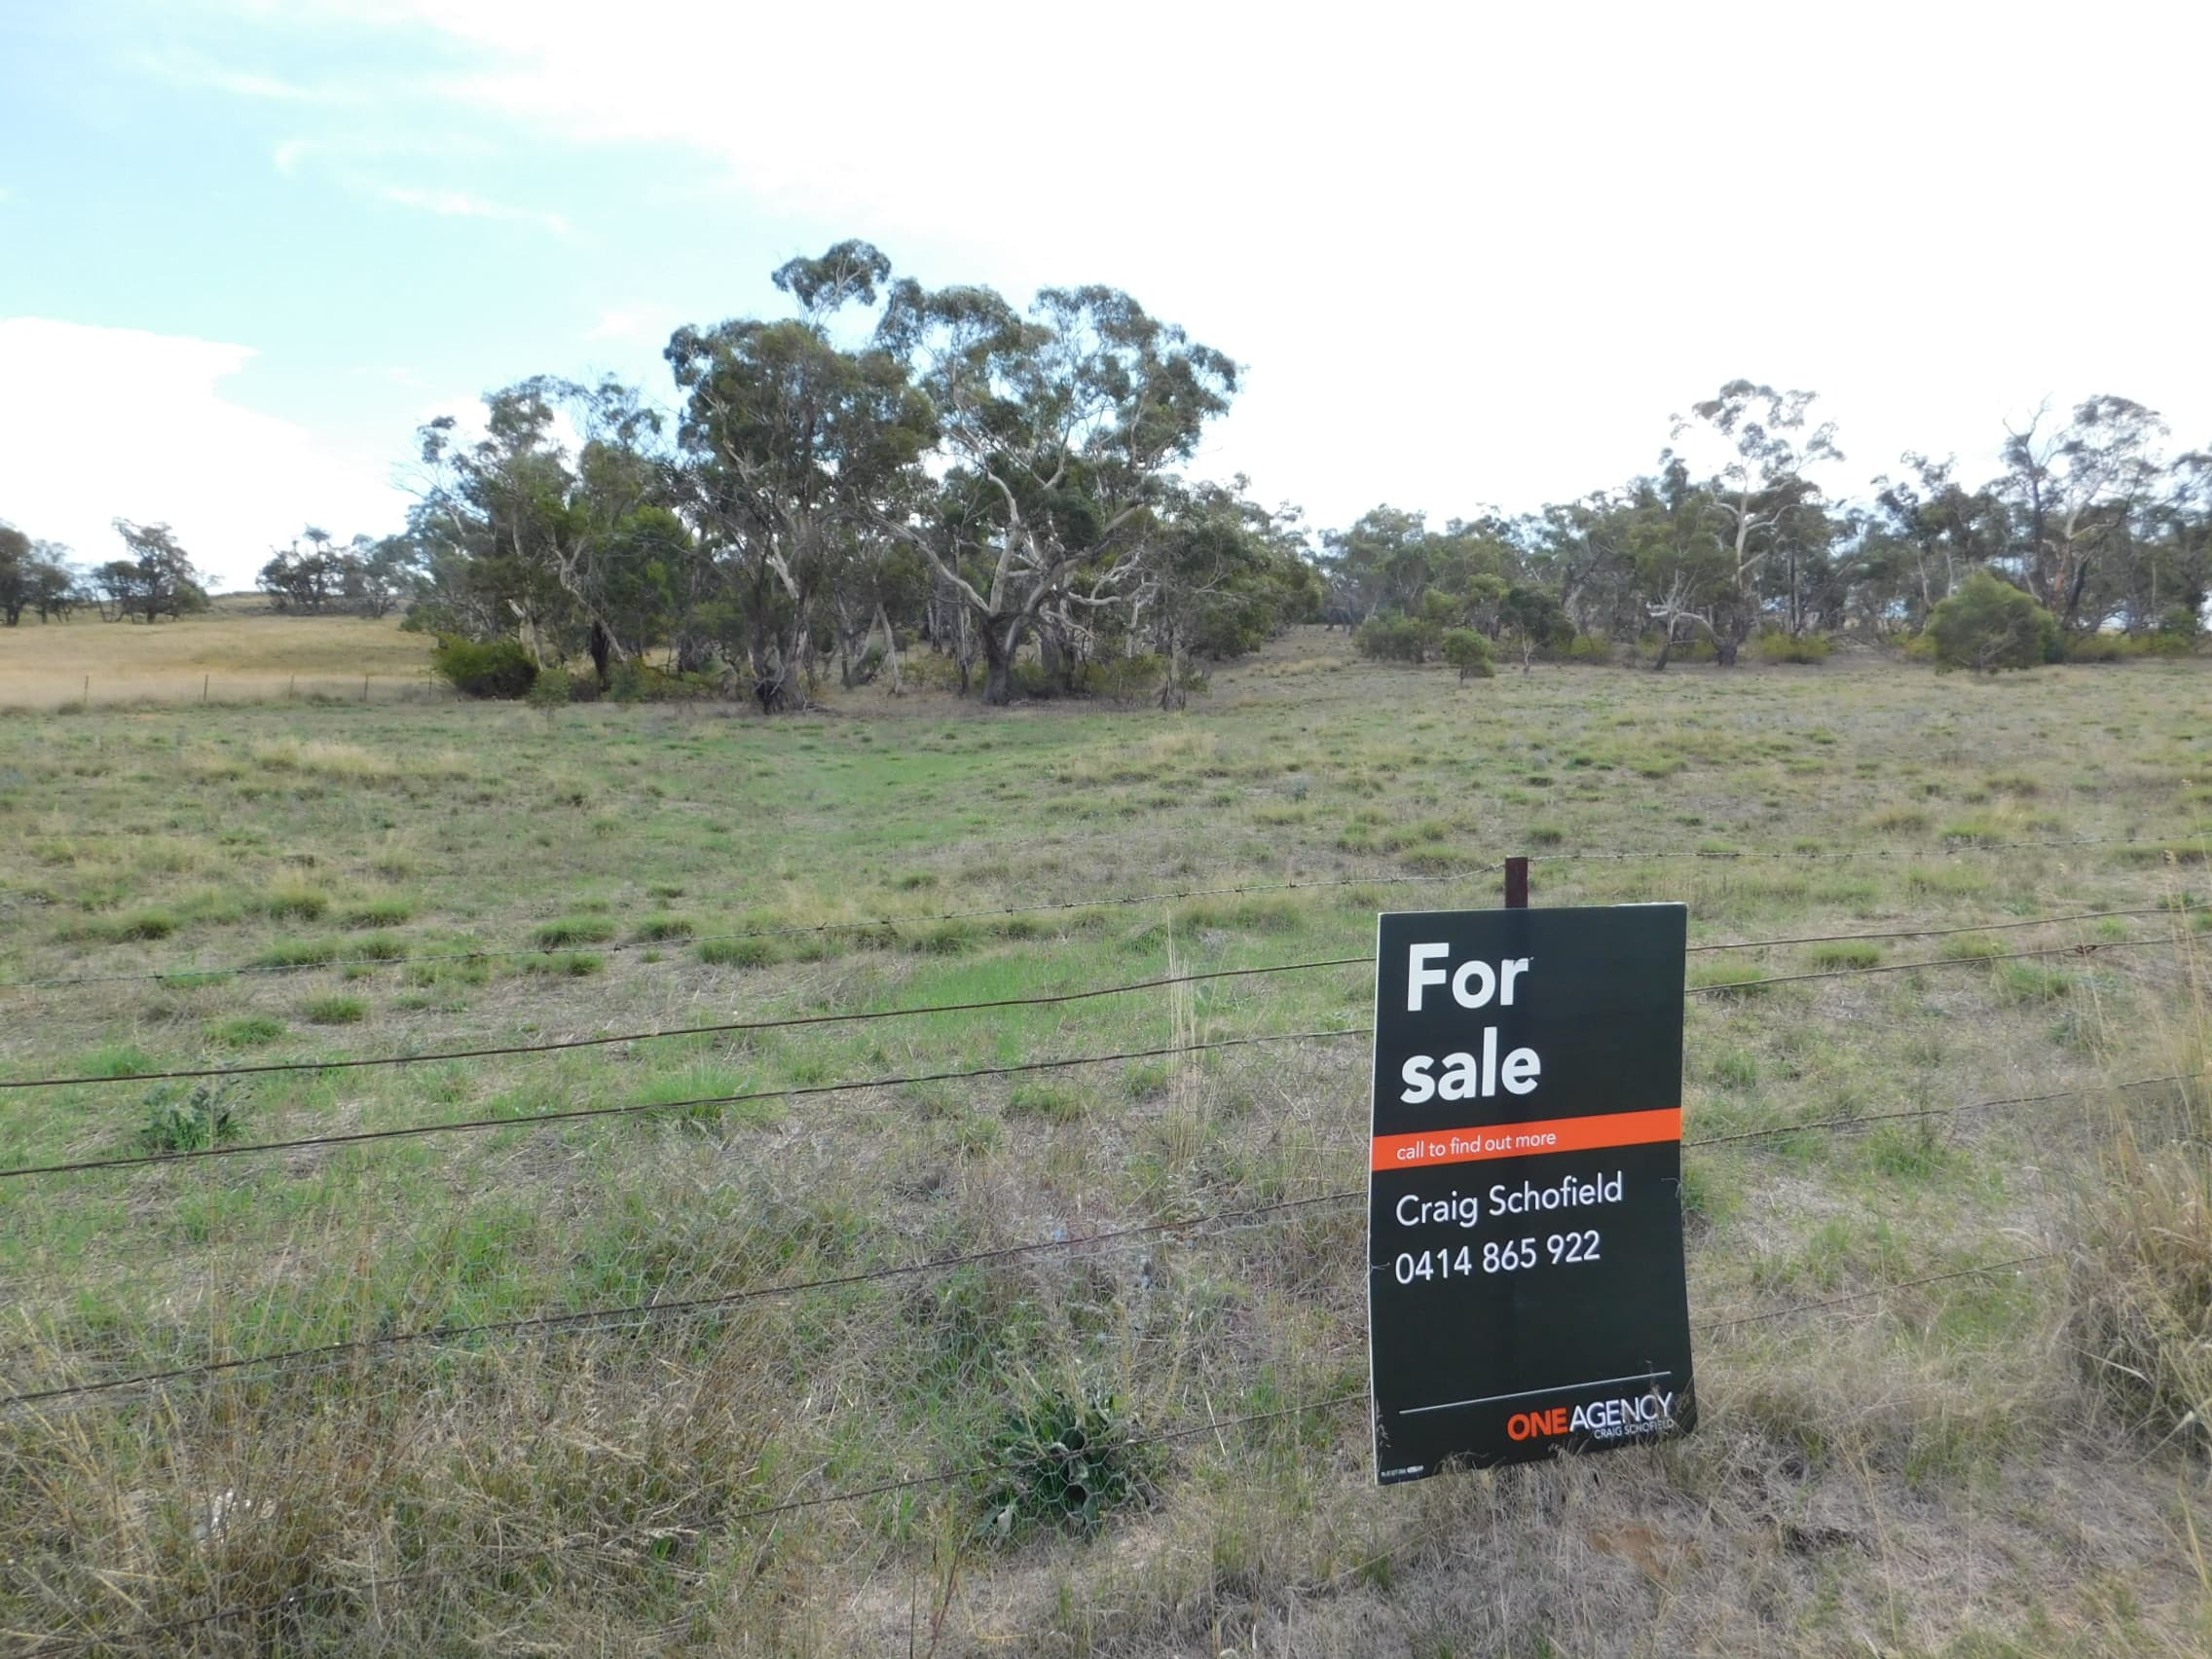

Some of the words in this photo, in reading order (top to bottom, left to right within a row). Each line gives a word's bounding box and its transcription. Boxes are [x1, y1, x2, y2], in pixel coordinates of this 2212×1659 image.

[1408, 942, 1533, 1012] For
[1400, 1026, 1541, 1104] sale
[1396, 1140, 1424, 1161] call
[1429, 1140, 1446, 1158] to
[1450, 1134, 1481, 1156] find
[1485, 1136, 1512, 1153] out
[1516, 1132, 1557, 1147] more
[1395, 1191, 1478, 1228] Craig
[1489, 1170, 1624, 1216] Schofield
[1395, 1245, 1472, 1284] 0414
[1483, 1237, 1537, 1272] 865
[1547, 1230, 1601, 1264] 922
[1594, 1424, 1623, 1439] CRAIG
